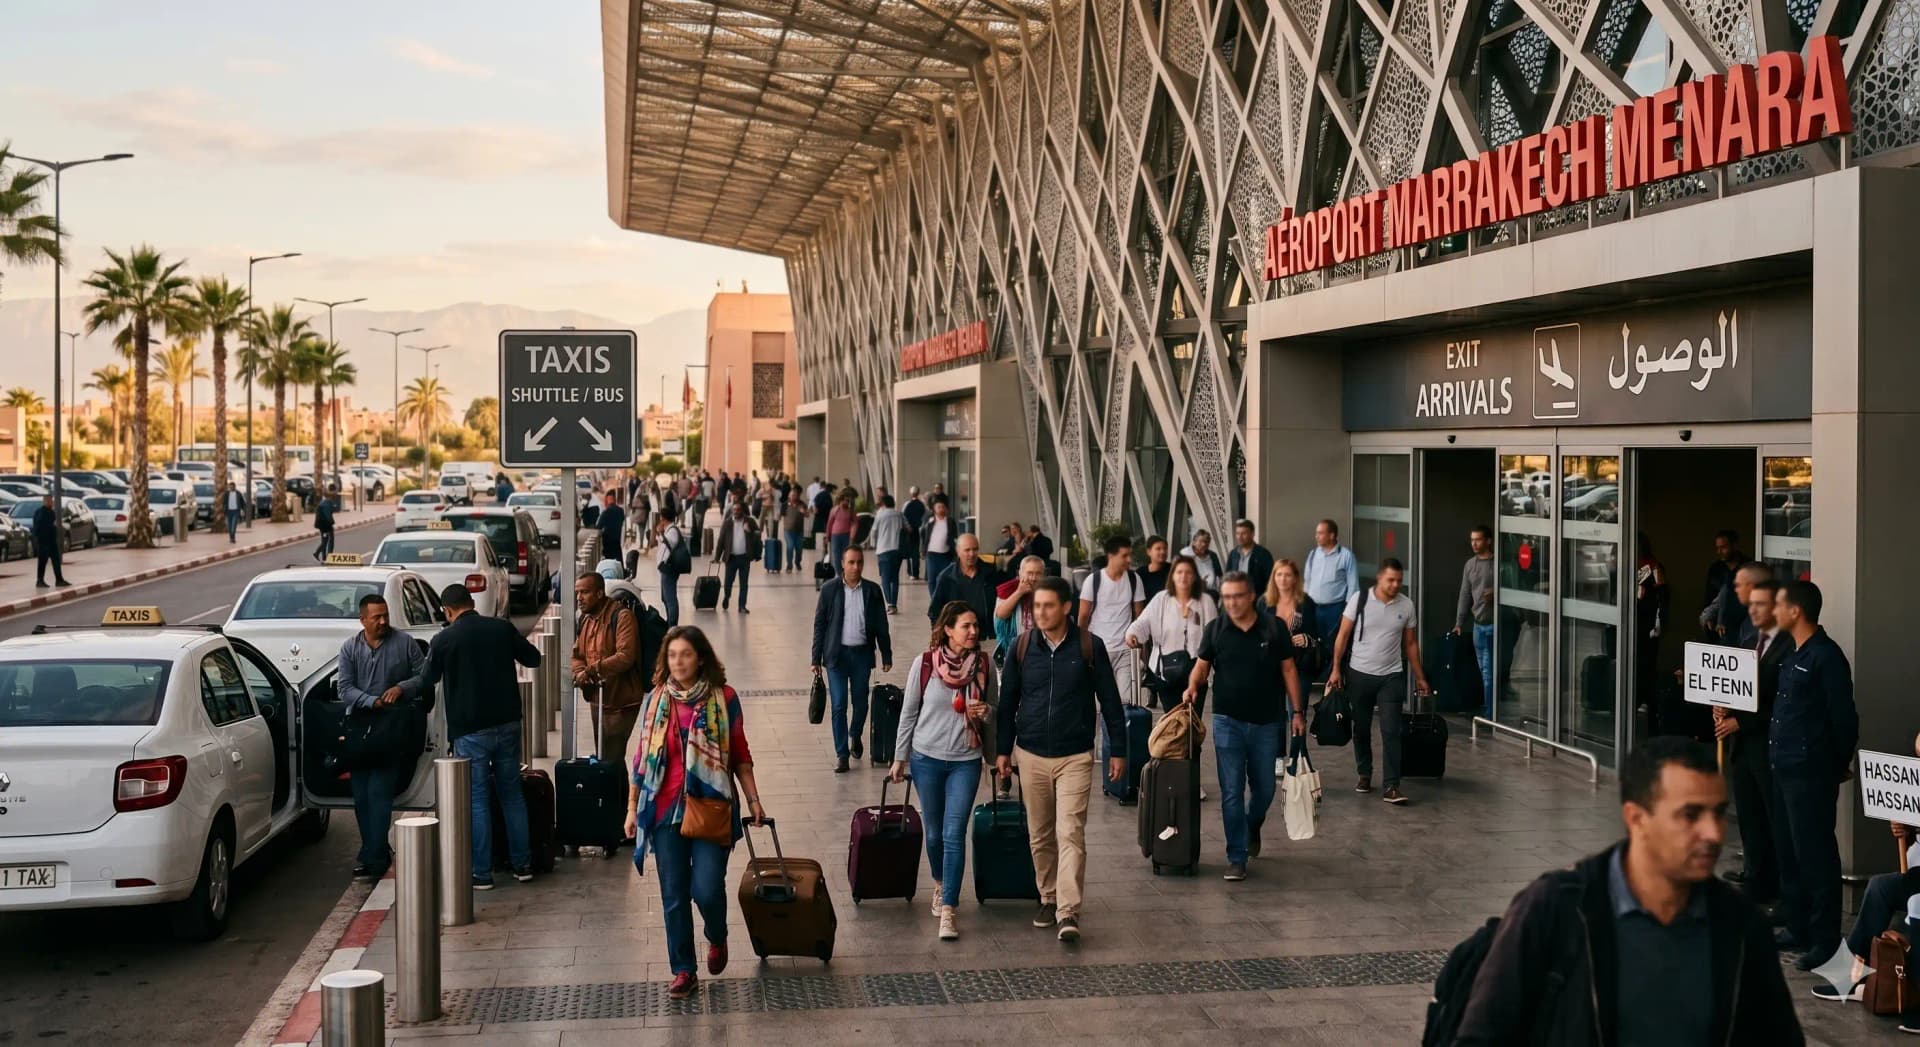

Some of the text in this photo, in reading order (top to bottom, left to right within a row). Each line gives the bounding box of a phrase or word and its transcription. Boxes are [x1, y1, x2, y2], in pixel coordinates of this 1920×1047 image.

[1264, 36, 1851, 281] AÉROPORT MARRAKECH MENARA
[524, 345, 611, 374] TAXIS
[1446, 340, 1481, 369] EXIT
[1608, 308, 1738, 395] الوصول
[511, 387, 579, 403] SHUTTLE
[594, 387, 624, 403] BUS
[1415, 376, 1513, 417] ARRIVALS
[331, 554, 357, 563] TAXIS
[111, 609, 150, 622] TAXIS
[1701, 652, 1739, 672] RIAD
[1689, 673, 1753, 698] EL FENN
[1864, 760, 1920, 787] HASSAN
[1866, 787, 1920, 815] HASSAN
